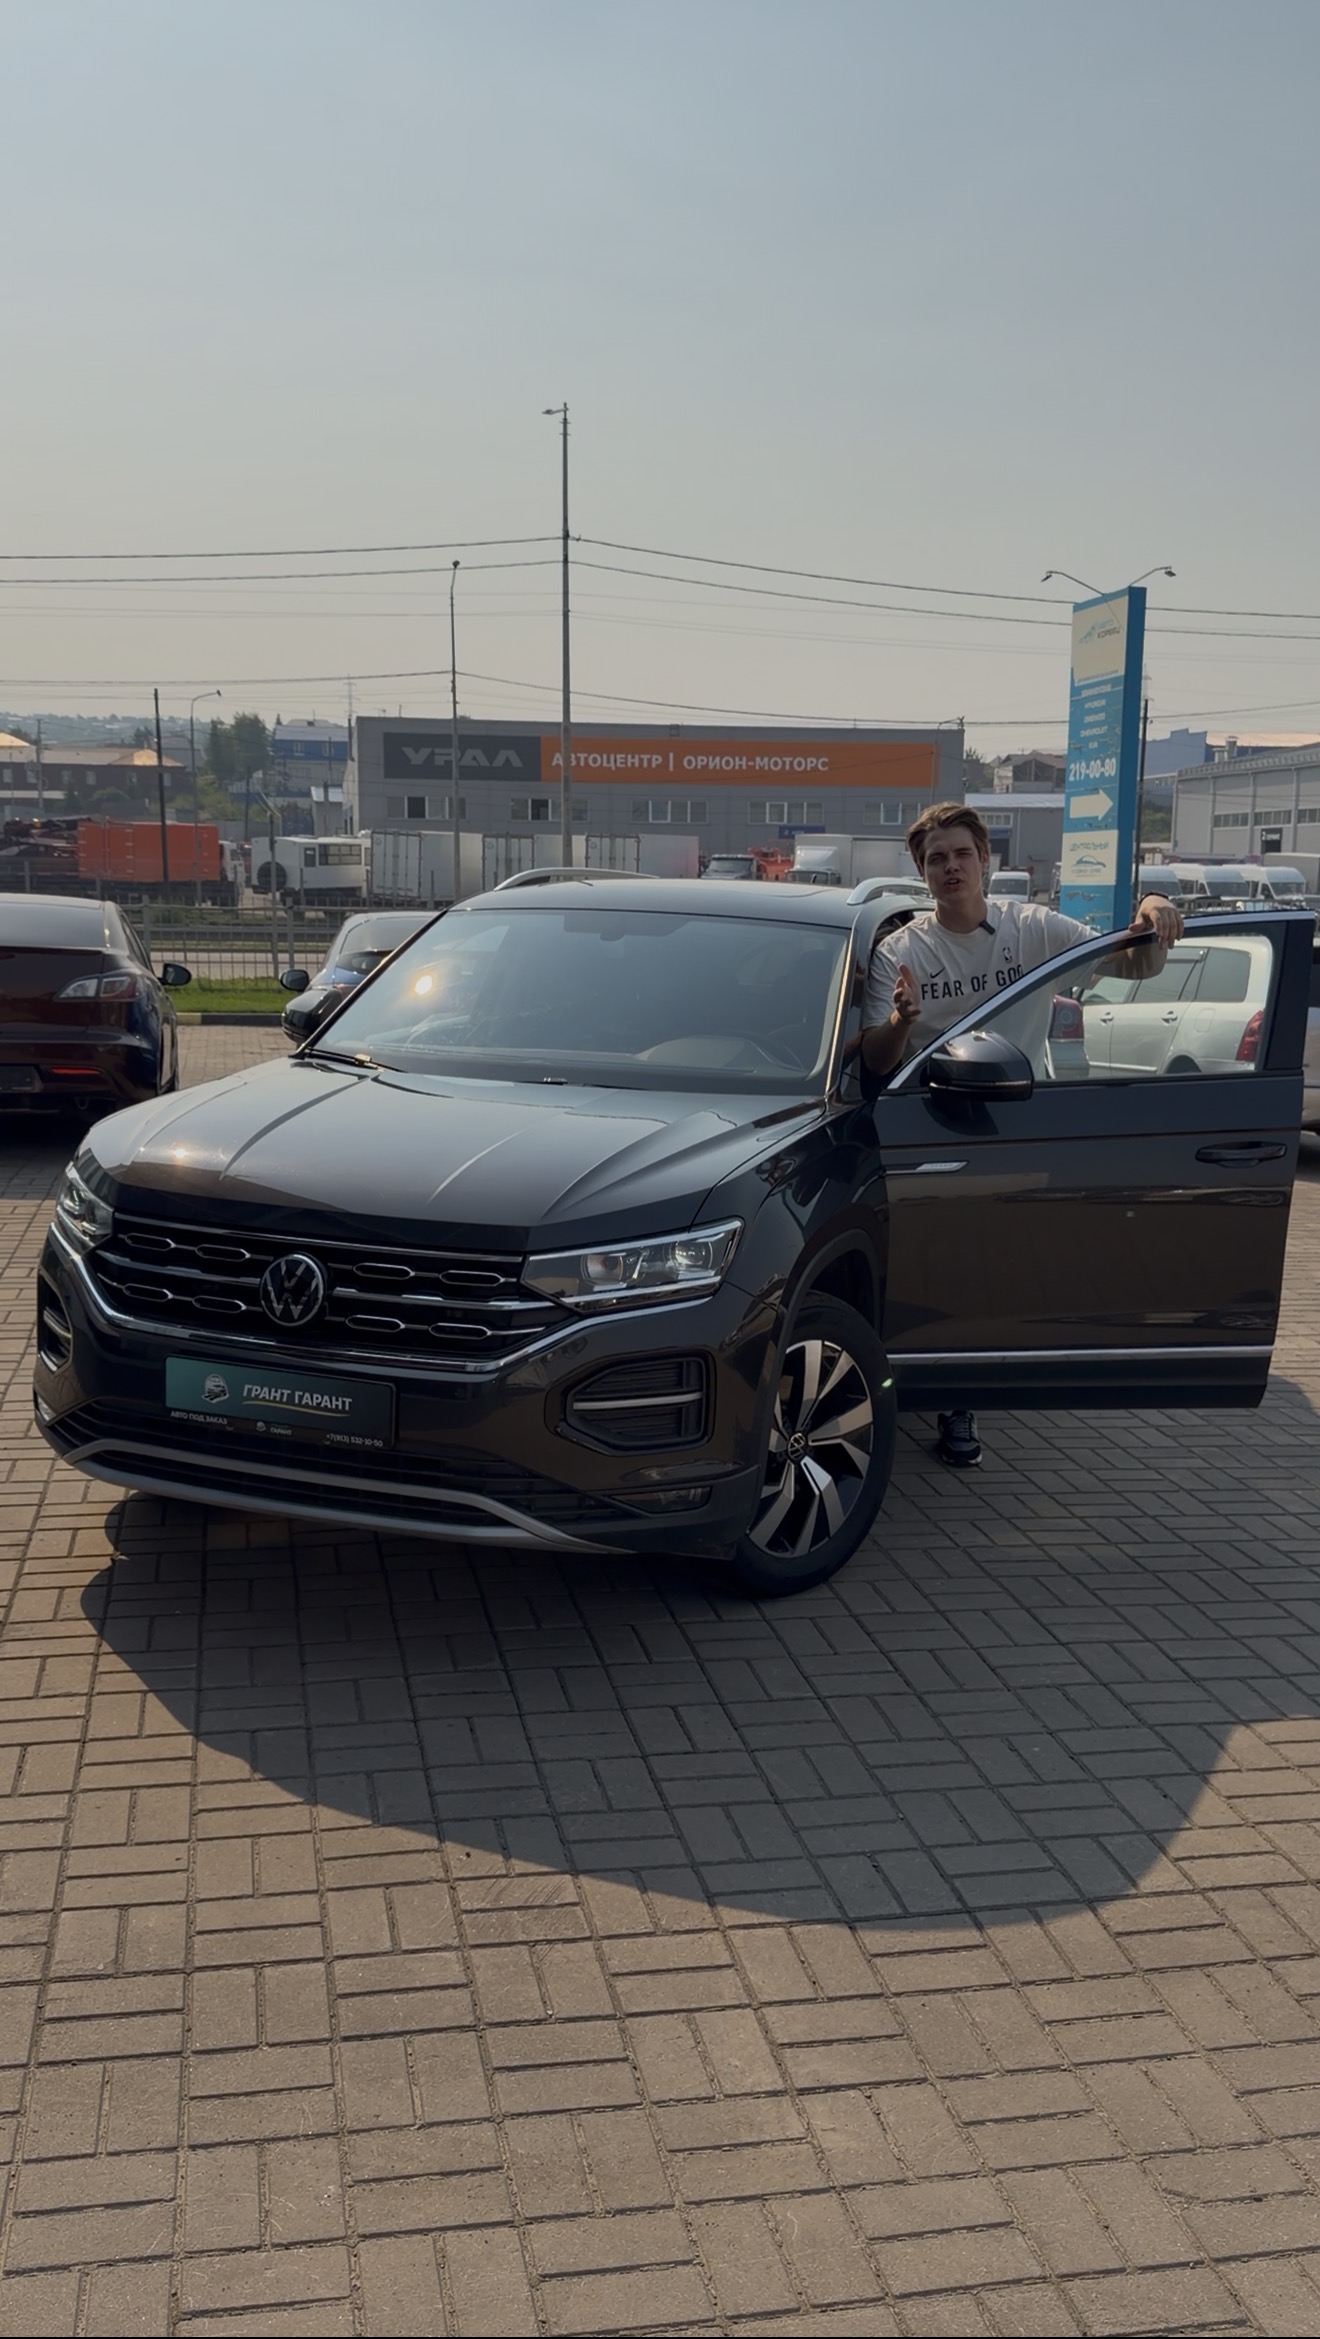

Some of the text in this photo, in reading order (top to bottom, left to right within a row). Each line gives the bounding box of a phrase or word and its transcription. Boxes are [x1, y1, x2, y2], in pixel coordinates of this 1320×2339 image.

[401, 746, 524, 768] УРАЛ
[683, 756, 829, 772] ОРИОН-МОТОРС
[1069, 757, 1117, 782] 219-00-80
[921, 980, 964, 1000] FEAR
[971, 973, 988, 993] OF
[242, 1384, 353, 1411] ГРАНТ ГАРАНТ
[170, 1410, 188, 1420] АВТО
[205, 1415, 228, 1425] ЗАКАЗ
